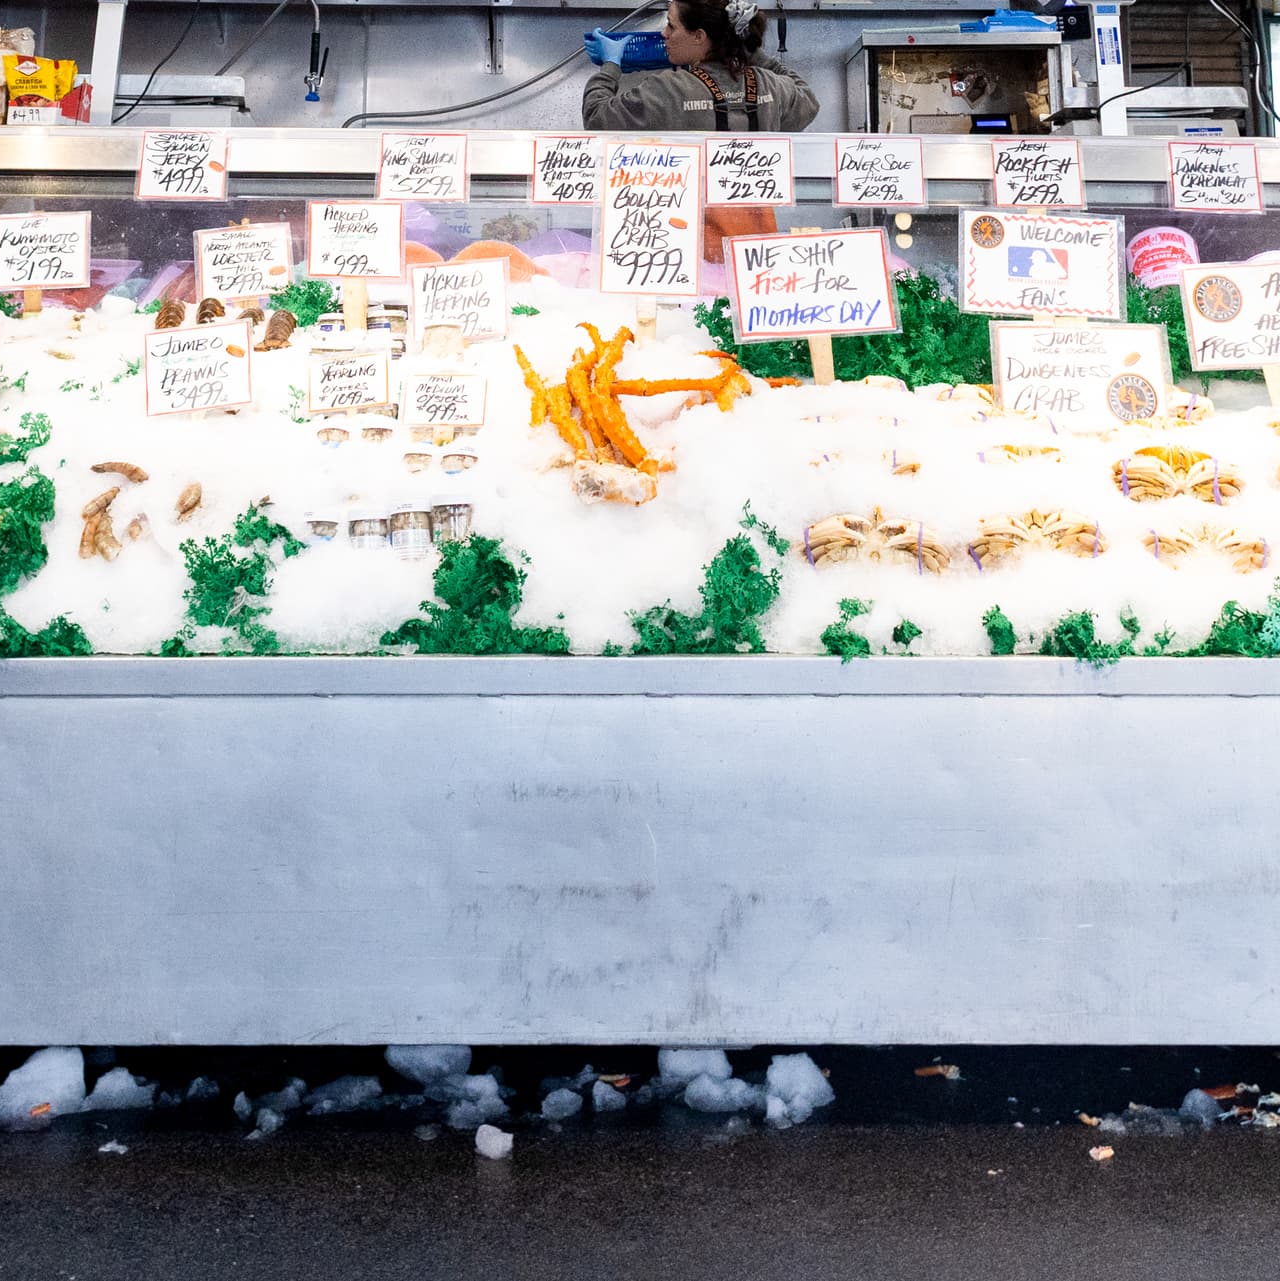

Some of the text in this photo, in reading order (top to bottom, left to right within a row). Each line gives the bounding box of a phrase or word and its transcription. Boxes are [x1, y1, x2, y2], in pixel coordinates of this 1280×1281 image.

[147, 154, 208, 168] JERKY
[382, 148, 409, 166] KING
[610, 143, 690, 170] GENUINE
[709, 150, 782, 169] LING COD
[839, 152, 916, 172] DOVER SOLE
[609, 167, 689, 189] ALASKAN
[1180, 173, 1248, 188] CRABMEAT
[613, 185, 688, 210] GOLDEN
[323, 204, 369, 221] PICKLED
[622, 207, 662, 229] KING
[328, 221, 378, 234] HERRING
[610, 225, 669, 250] CRAB
[1020, 223, 1110, 247] WELCOME
[0, 229, 79, 248] KUMAMOTO
[19, 245, 75, 257] OYSTERS
[212, 250, 274, 266] LOBSTER
[745, 239, 844, 271] WE SHIP
[422, 270, 483, 292] PICKLED
[750, 270, 804, 295] FISH
[425, 291, 490, 312] HERRING
[1017, 287, 1069, 307] FANS
[748, 298, 881, 332] MOTHERS DAY
[150, 336, 223, 358] JUMBO
[1032, 330, 1104, 346] JUMBO
[1198, 336, 1249, 363] FREE
[160, 362, 229, 389] PRAWNS
[321, 366, 376, 383] YEARLING
[1007, 356, 1111, 381] DUNGENESS
[322, 384, 369, 393] OYSTERS
[416, 382, 465, 394] MEDIUM
[416, 393, 468, 405] OYSTERS
[1014, 385, 1085, 413] CRAB
